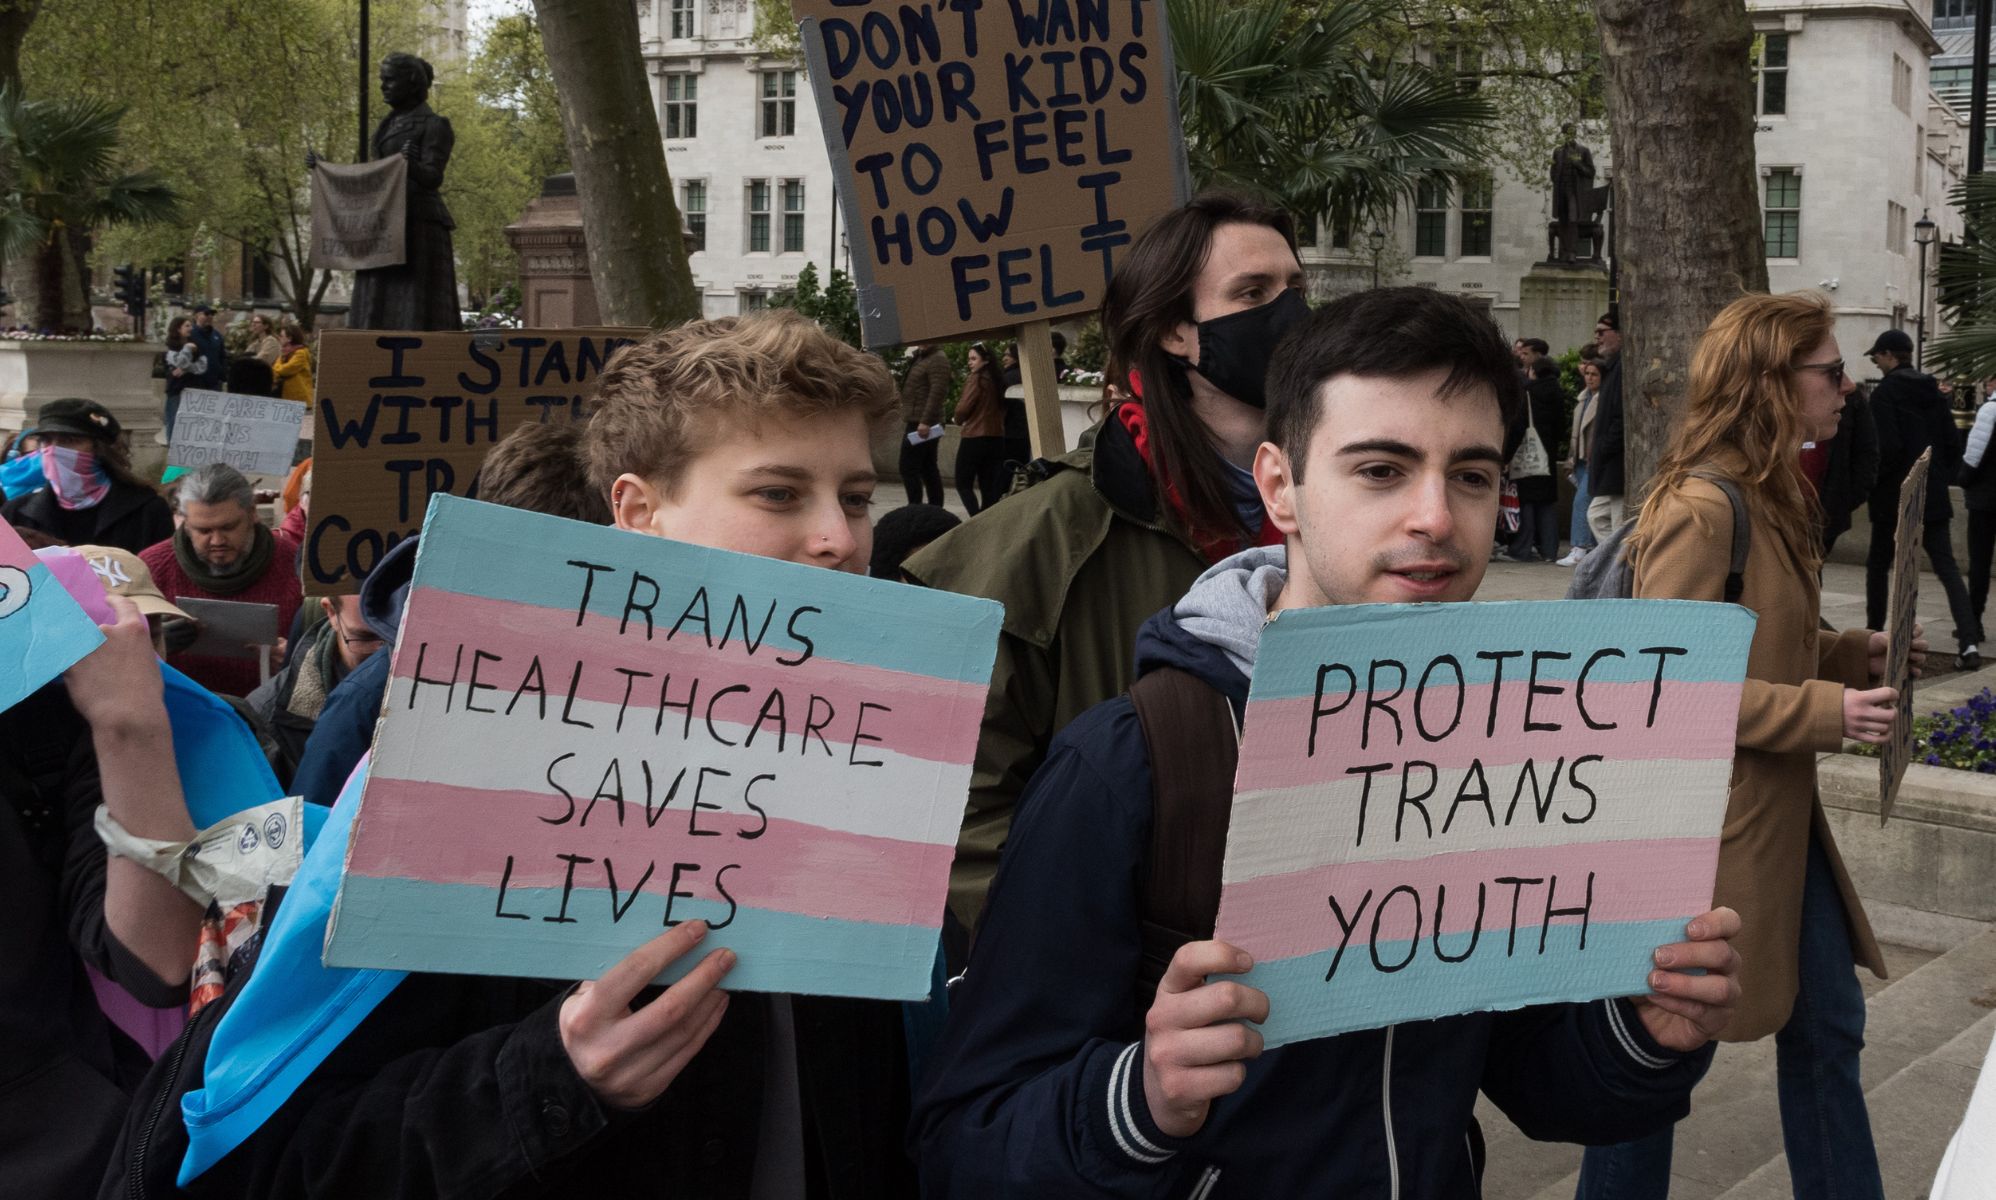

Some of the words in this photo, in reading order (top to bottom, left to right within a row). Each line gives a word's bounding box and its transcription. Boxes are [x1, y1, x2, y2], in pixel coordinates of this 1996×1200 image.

[819, 0, 983, 79] DON'T
[1010, 0, 1149, 48] WANT
[833, 61, 981, 150] YOUR
[1004, 42, 1147, 112] KIDS
[855, 142, 942, 209] TO
[973, 109, 1133, 181] FEEL
[871, 186, 1014, 265] HOW
[1077, 171, 1126, 238] I
[950, 233, 1131, 322] FELT
[184, 391, 217, 414] WE
[222, 397, 268, 419] ARE
[368, 337, 425, 389] I
[457, 337, 640, 394] STAN
[176, 444, 260, 471] YOUTH
[180, 418, 251, 444] TRANS
[320, 394, 498, 449] WITH
[566, 560, 821, 666] TRANS
[408, 642, 892, 767] HEALTHCARE
[1307, 647, 1689, 757] PROTECT
[537, 753, 776, 840] SAVES
[1345, 754, 1604, 847] TRANS
[495, 853, 741, 930] LIVES
[1325, 871, 1595, 982] YOUTH
